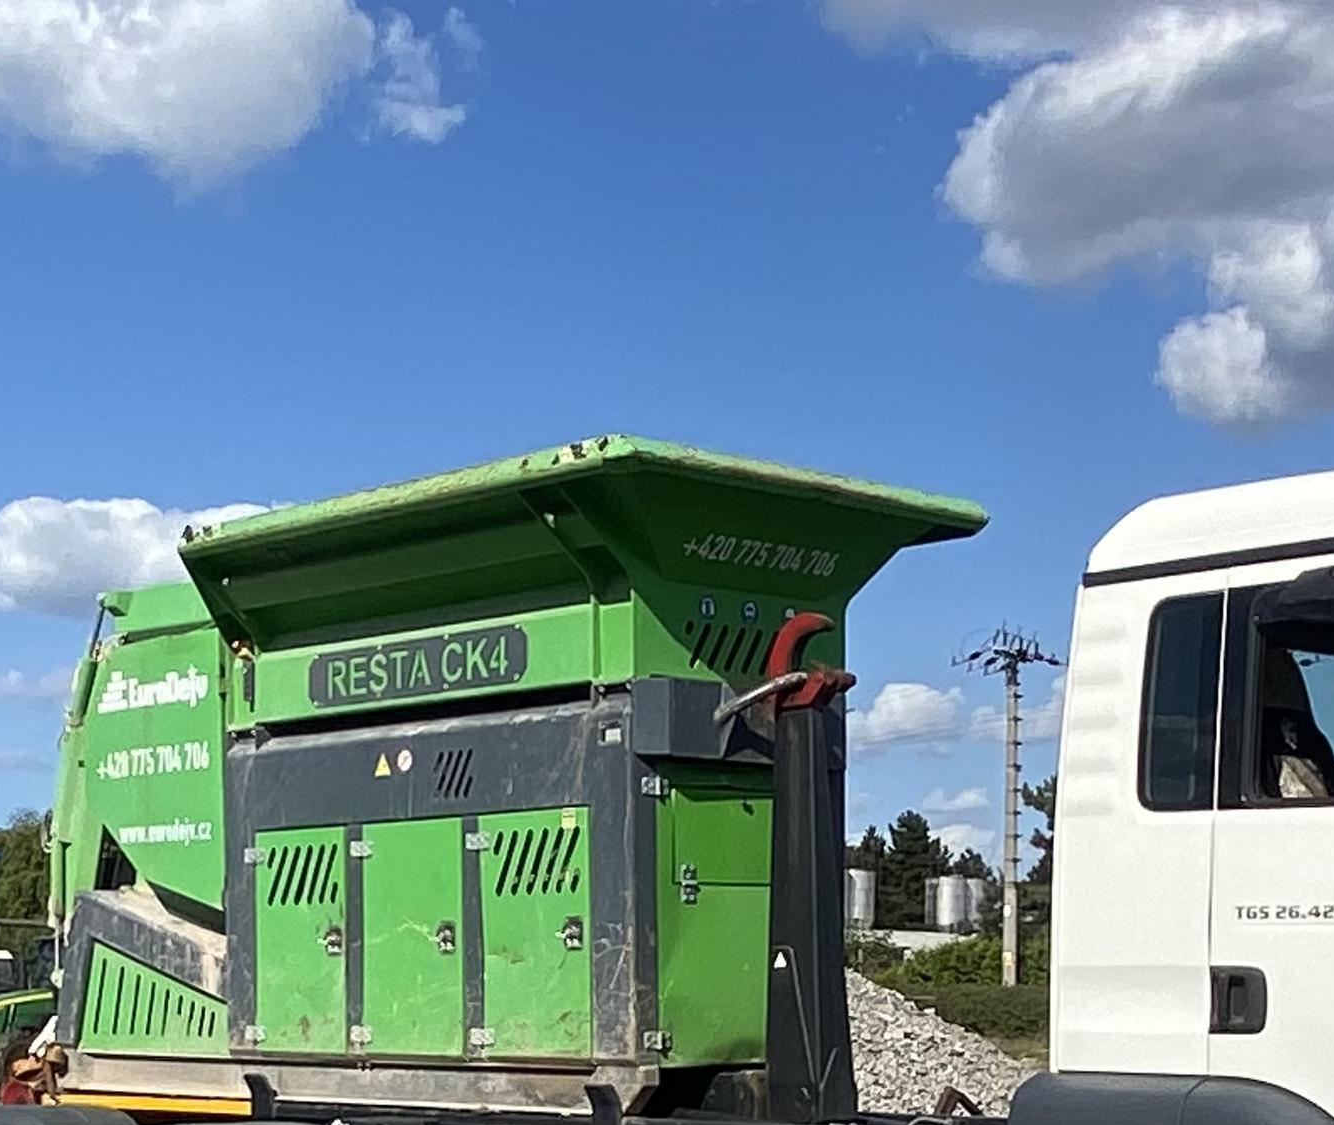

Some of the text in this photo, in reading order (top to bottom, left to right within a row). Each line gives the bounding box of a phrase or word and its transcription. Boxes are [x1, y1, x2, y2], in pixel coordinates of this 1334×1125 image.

[683, 533, 840, 577] +420 775 704 706
[327, 635, 509, 700] RESTA CK4
[96, 740, 211, 780] +420 775 704 706
[119, 817, 213, 847] www.eurodejv.cz
[1235, 904, 1270, 920] TGS
